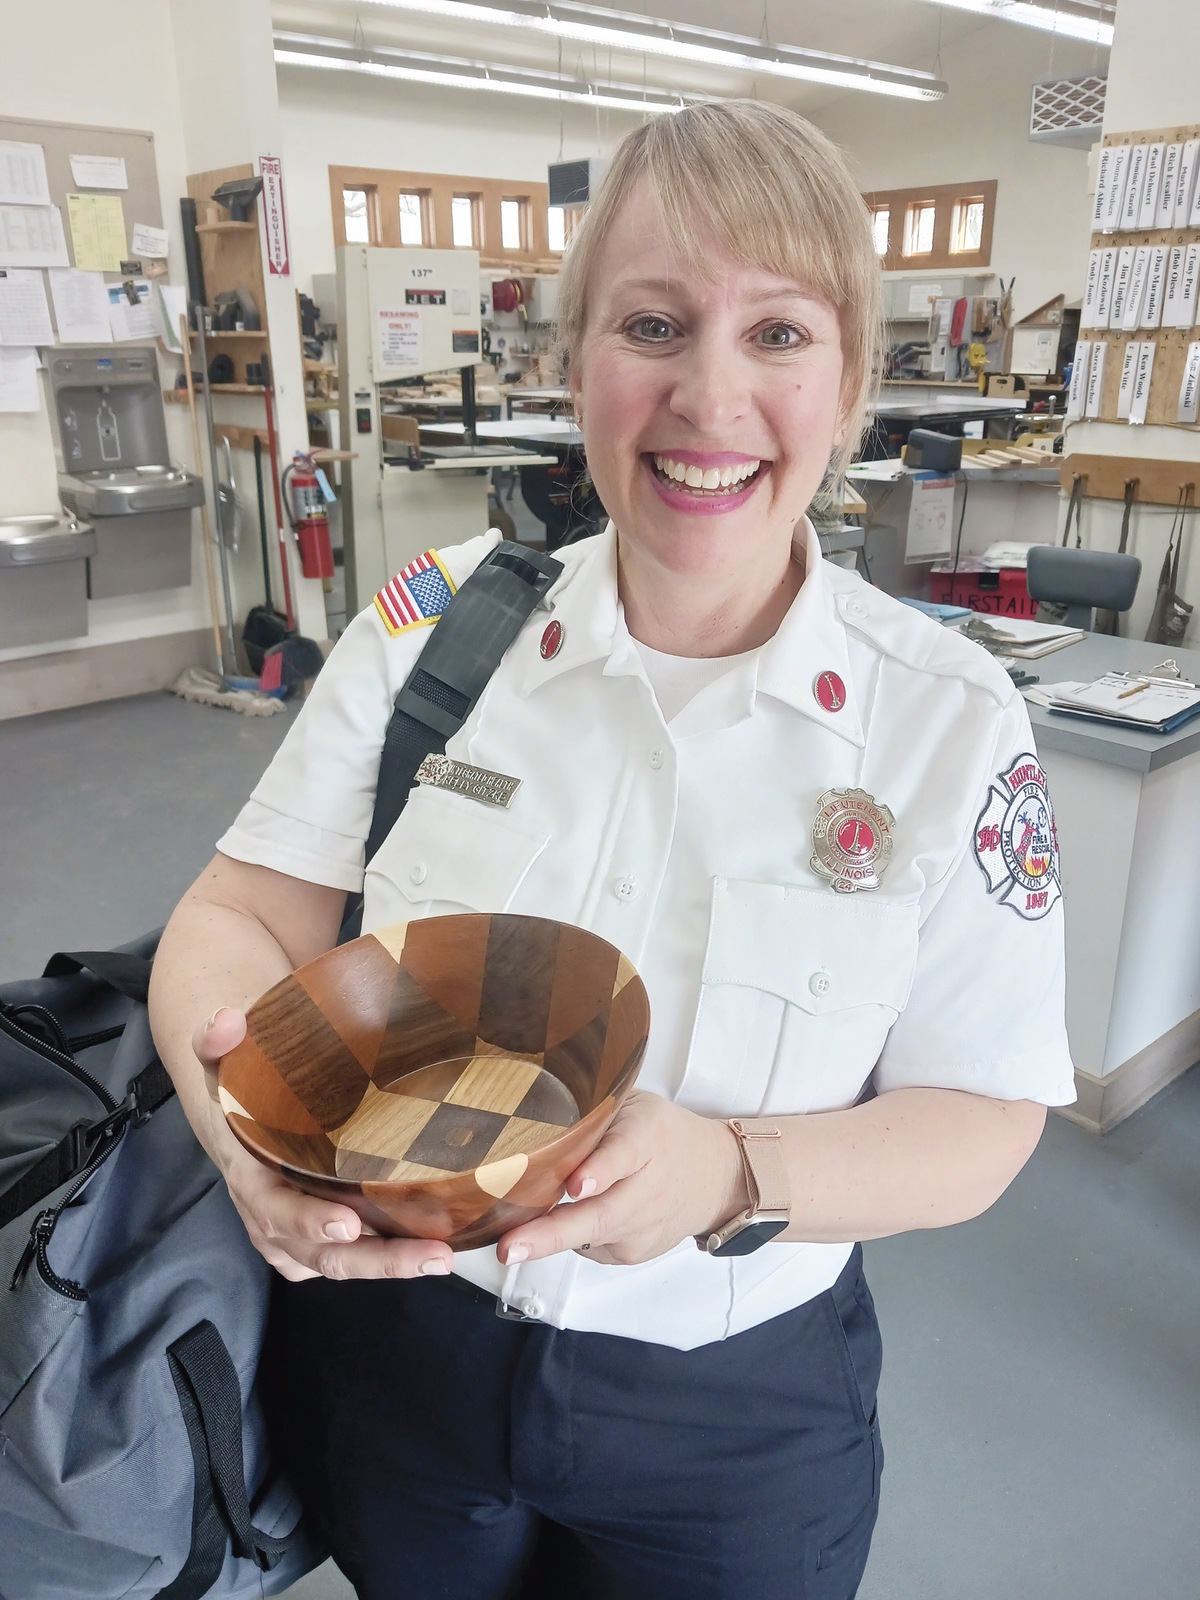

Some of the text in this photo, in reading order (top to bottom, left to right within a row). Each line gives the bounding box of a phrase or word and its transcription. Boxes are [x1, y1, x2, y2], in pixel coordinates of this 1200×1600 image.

[261, 162, 279, 175] FIRE
[1113, 156, 1124, 182] Donna
[1145, 149, 1159, 205] Paul Dehnert
[1162, 152, 1176, 211] Rich Escallier
[1179, 166, 1188, 188] Mark
[1095, 154, 1109, 219] Richard Abbott
[1127, 156, 1142, 217] Dominic Citarelli
[268, 176, 282, 267] EXTINGUISHER
[1089, 260, 1097, 281] Andy
[1098, 253, 1112, 316] Pam Kozlowski
[1134, 258, 1145, 277] Tony
[1168, 253, 1181, 300] Bob Olesen
[1183, 255, 1196, 300] Tony Pratt
[409, 294, 443, 305] JET
[1115, 265, 1129, 319] Jim Lindgren
[1147, 255, 1163, 320] Dan Marandola
[1092, 346, 1101, 375] Karen
[1124, 354, 1132, 369] Jim
[1136, 354, 1149, 399] Ken Woods
[1183, 374, 1196, 408] Zielinski
[1023, 786, 1039, 797] FIRE
[824, 800, 889, 833] LIEUTENANT
[1003, 831, 1042, 888] PROTECTION
[1031, 844, 1051, 855] RESCUE
[822, 854, 875, 880] ILLINOIS
